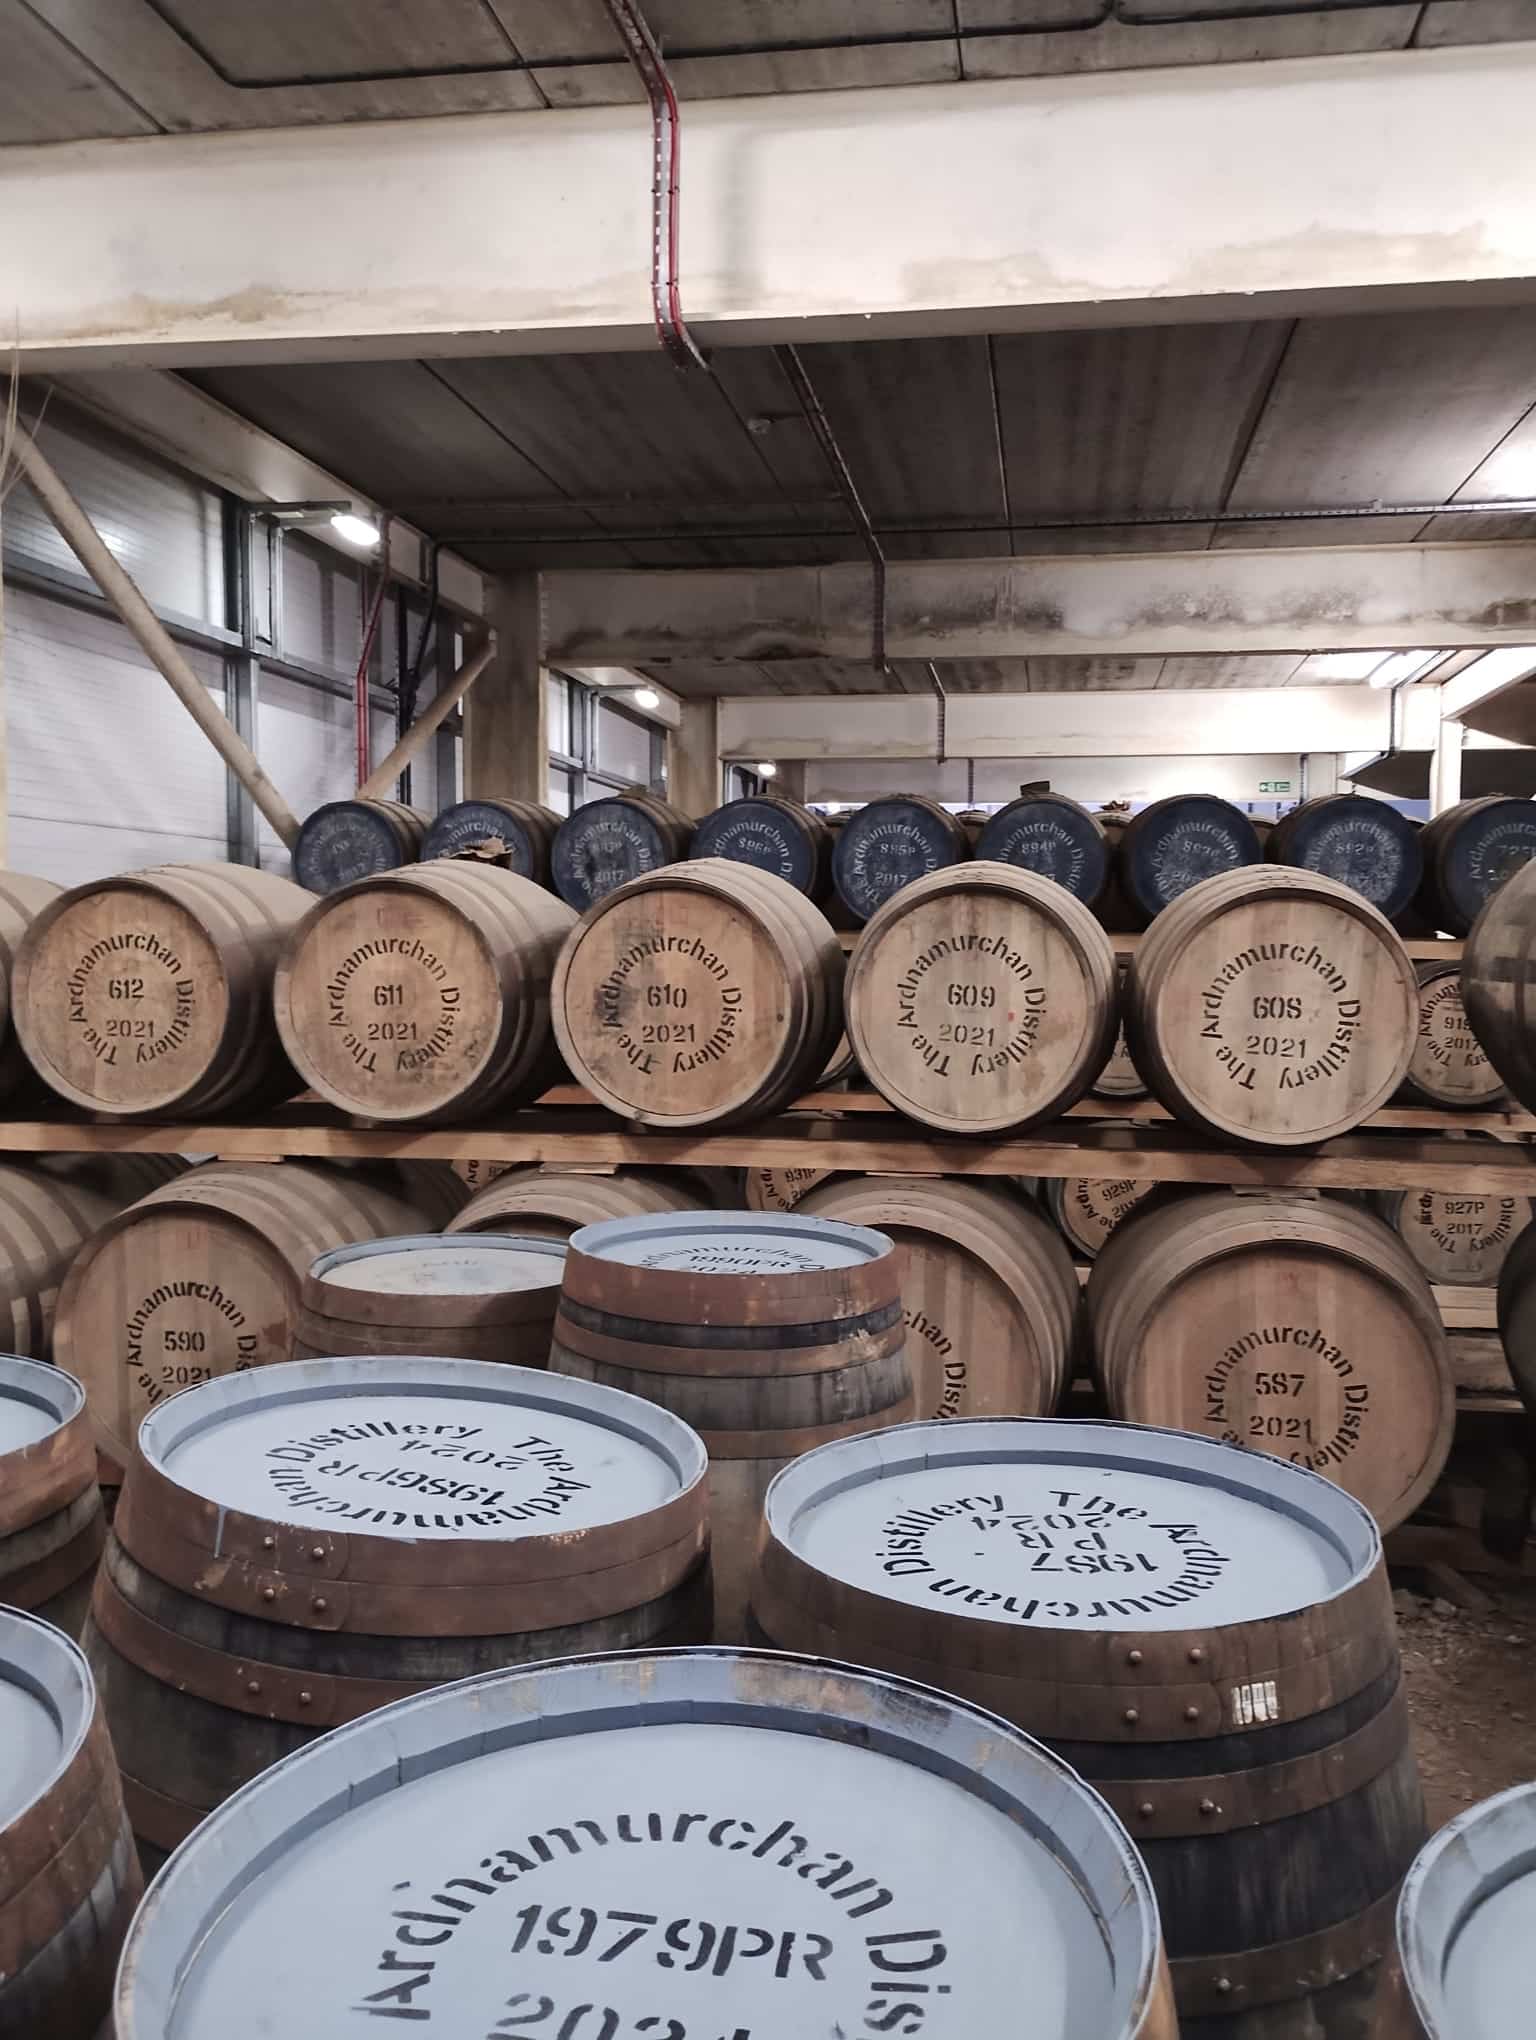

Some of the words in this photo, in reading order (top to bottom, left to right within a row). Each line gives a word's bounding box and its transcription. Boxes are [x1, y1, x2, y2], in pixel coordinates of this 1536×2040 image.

[67, 934, 182, 1023] Ardnamurchan
[108, 978, 145, 1000] 612
[327, 938, 448, 1027] Ardnamurchan
[373, 984, 404, 1006] 611
[601, 936, 729, 1029] Ardnamurchan
[647, 983, 688, 1008] 610
[897, 935, 1033, 1028] Ardnamurchan
[948, 983, 996, 1008] 609
[1200, 943, 1348, 1040] Ardnamurchan
[135, 979, 196, 1064] Distillery
[1252, 995, 1303, 1020] 608
[83, 1028, 118, 1065] The
[105, 1019, 155, 1038] 2021
[367, 1021, 418, 1041] 2021
[397, 987, 461, 1072] Distillery
[642, 1023, 696, 1043] 2021
[673, 987, 743, 1073] Distillery
[938, 1023, 995, 1047] 2021
[970, 987, 1048, 1076] Distillery
[1245, 1035, 1307, 1060] 2021
[1278, 999, 1361, 1090] Distillery
[342, 1033, 377, 1073] The
[617, 1034, 654, 1075] The
[911, 1034, 951, 1078] The
[1215, 1046, 1257, 1091] The
[1445, 1201, 1485, 1215] 927P
[1446, 1223, 1484, 1235] 2017
[125, 1281, 246, 1367] Ardnamurchan
[164, 1331, 205, 1351] 590
[1202, 1327, 1353, 1423] Ardnamurchan
[1255, 1372, 1305, 1397] 587
[264, 1421, 484, 1463] Distillery
[1250, 1415, 1313, 1445] 2021
[400, 1439, 529, 1471] 2024
[512, 1435, 575, 1472] The
[268, 1466, 592, 1529] Ardnamurchan
[317, 1460, 505, 1507] 1986PR
[970, 1511, 1112, 1532] 2024
[1049, 1490, 1149, 1520] The
[875, 1494, 1005, 1577] Distillery
[928, 1523, 1231, 1620] Ardnamurchan
[1030, 1552, 1160, 1575] 1987
[350, 1812, 895, 2021] Ardnamurchan
[510, 1904, 834, 1981] 1979PR
